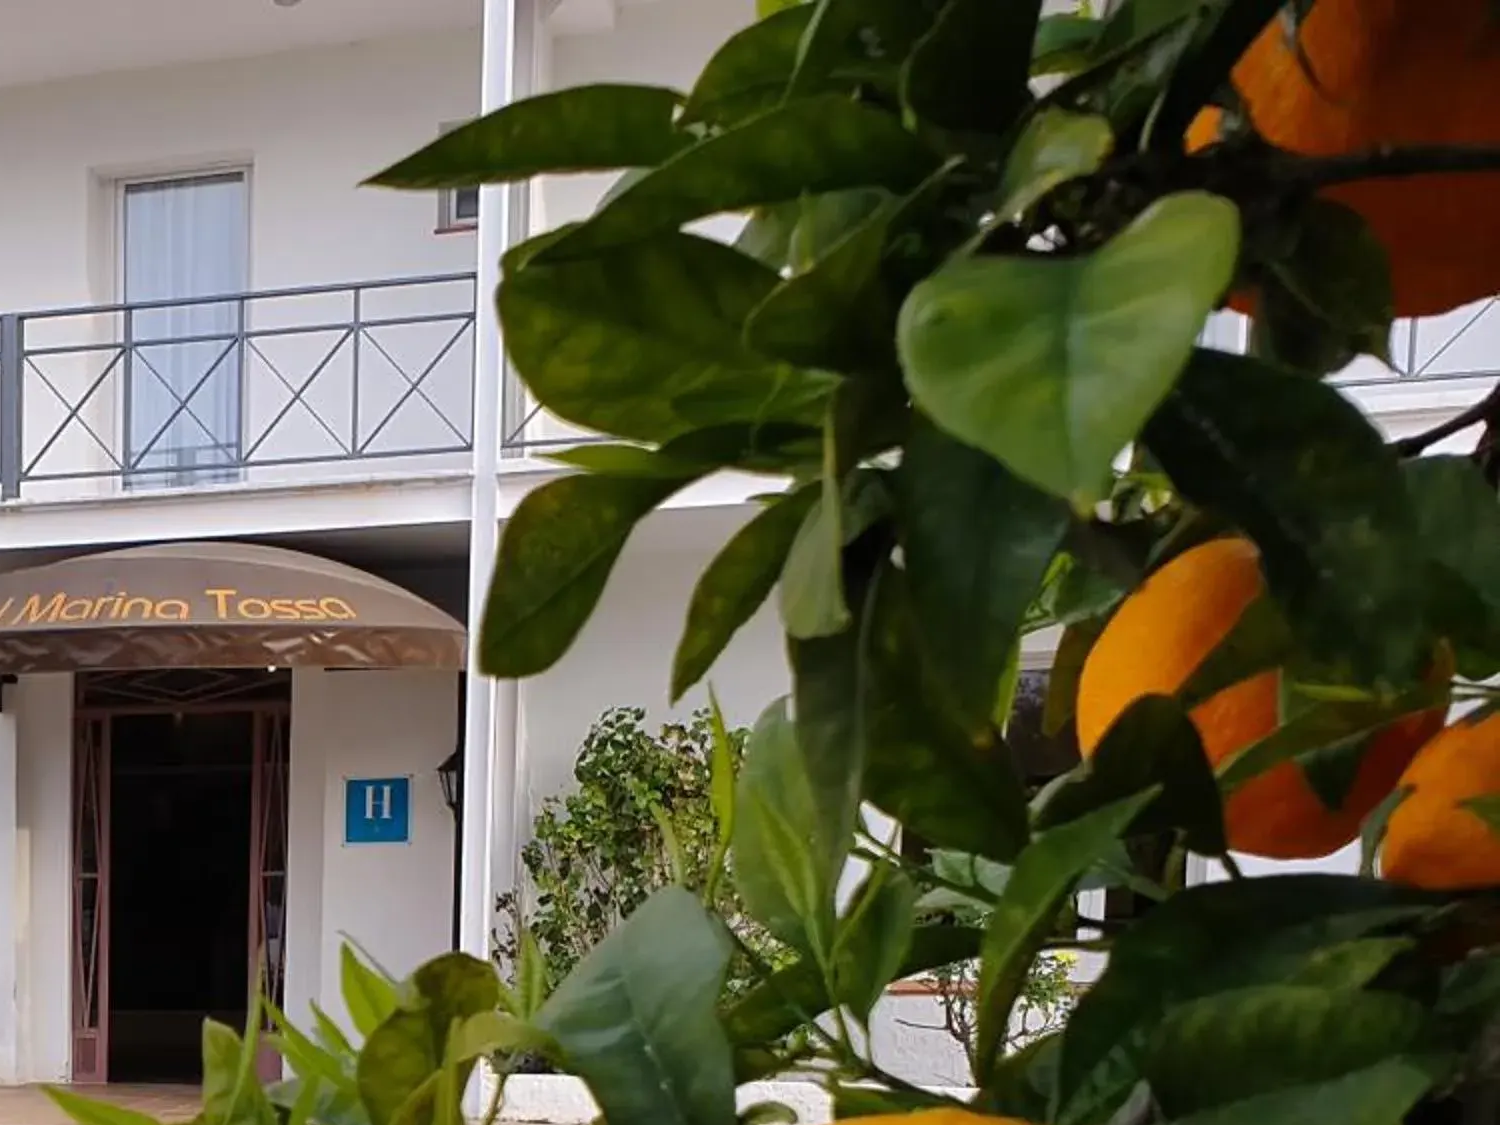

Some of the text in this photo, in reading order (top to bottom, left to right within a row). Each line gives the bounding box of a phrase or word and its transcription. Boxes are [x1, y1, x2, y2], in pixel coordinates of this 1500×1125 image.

[12, 590, 188, 624] Marina
[205, 588, 356, 620] Tossa
[364, 785, 393, 819] H
